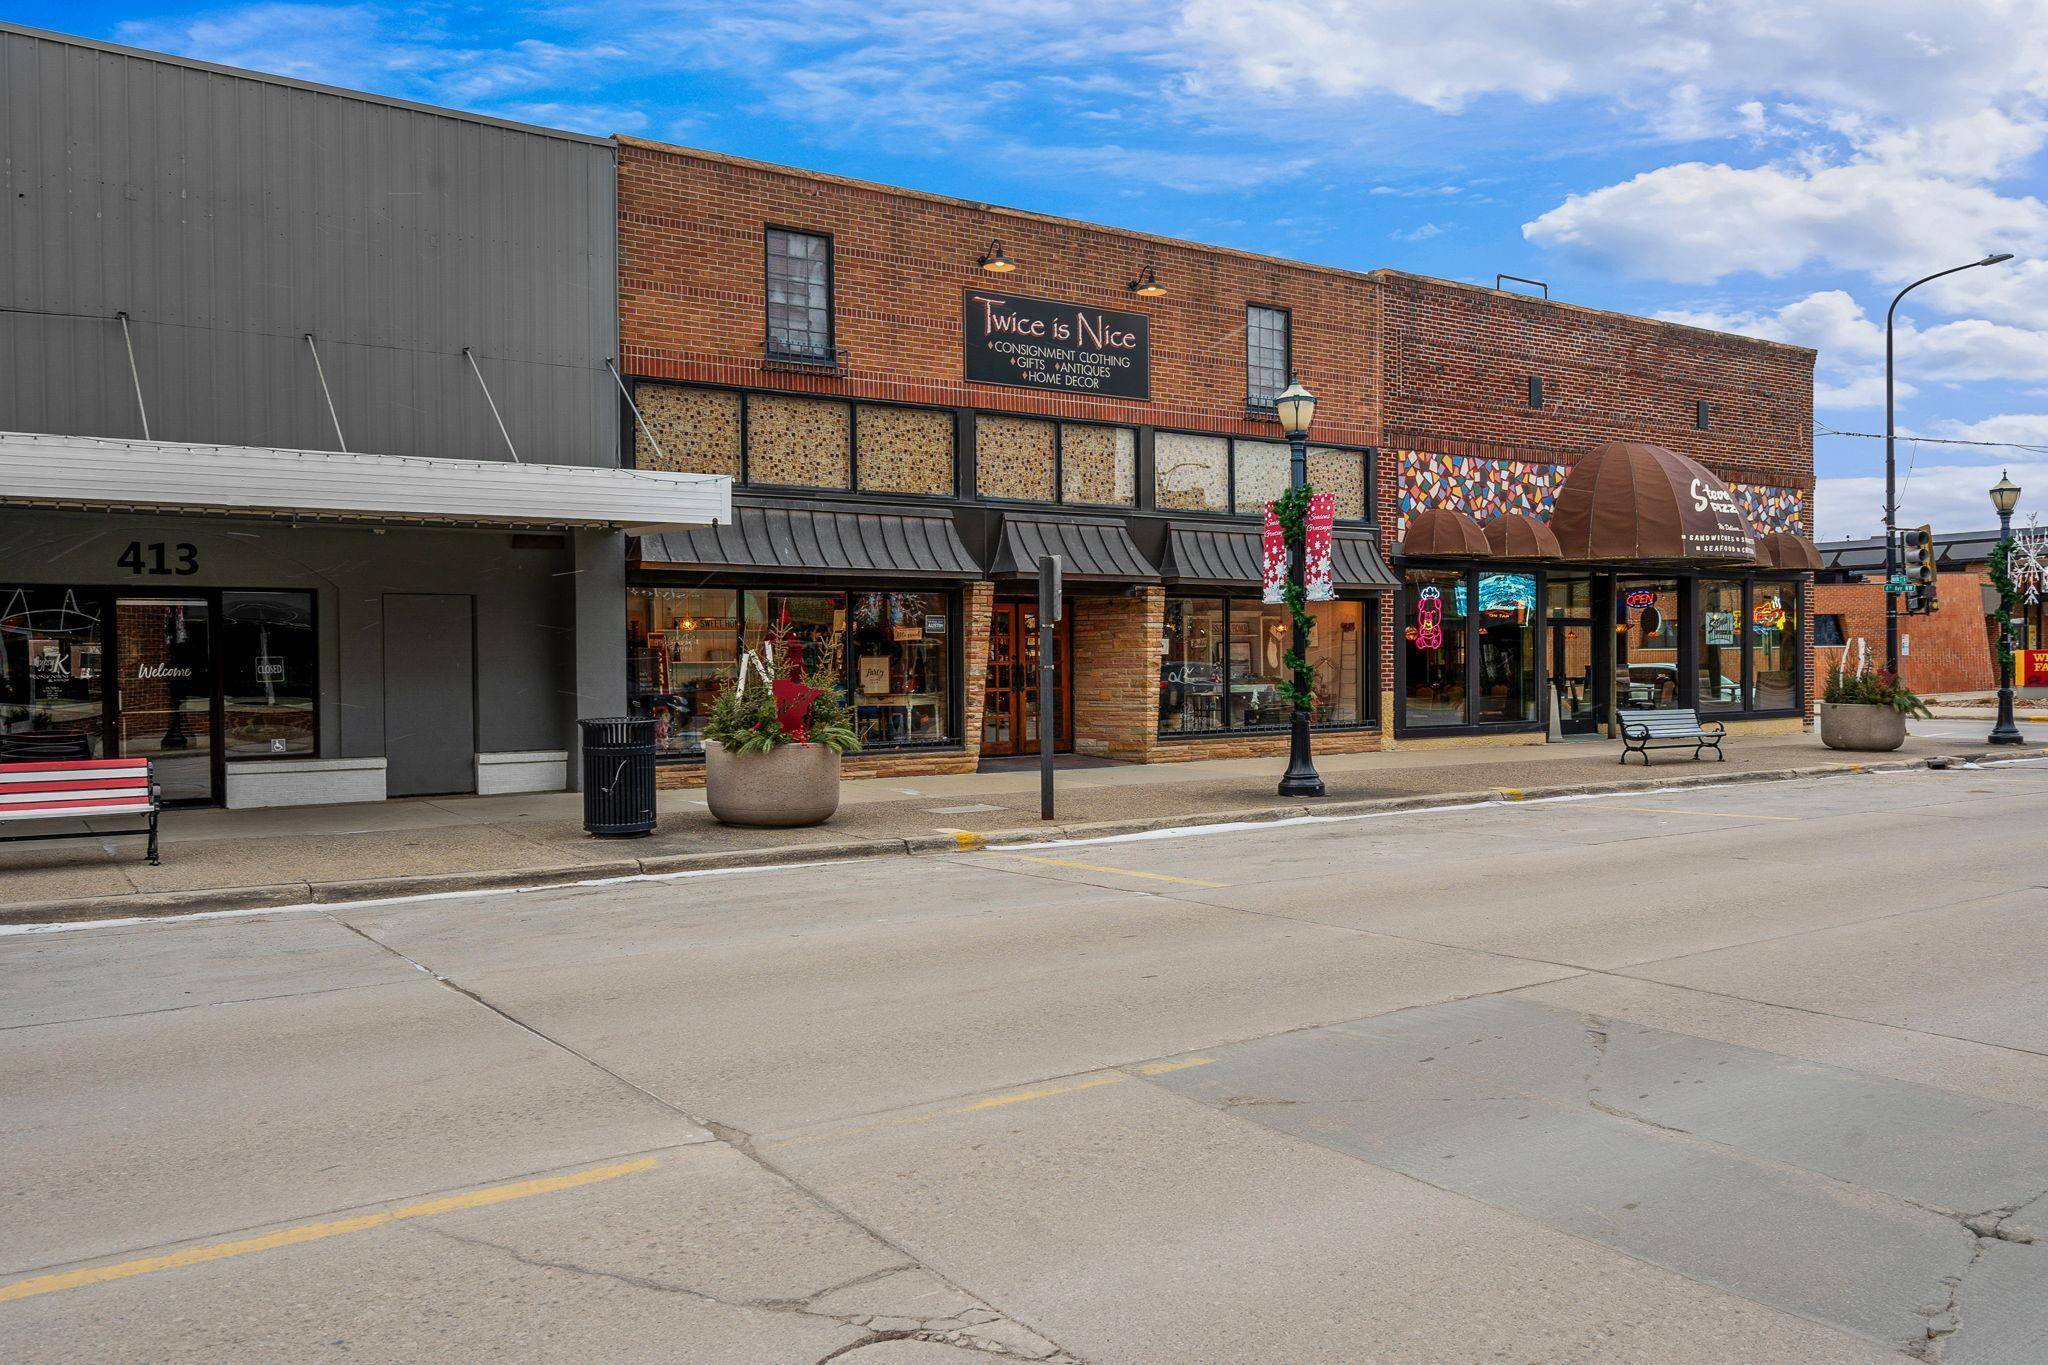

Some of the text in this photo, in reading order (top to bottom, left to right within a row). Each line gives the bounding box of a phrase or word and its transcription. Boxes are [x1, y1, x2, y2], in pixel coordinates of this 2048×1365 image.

[971, 296, 1136, 350] Twice is Nice
[994, 341, 1131, 368] CONSIGNMENT CLOTHING
[1017, 356, 1111, 378] GIFTS ANTIQUES
[1028, 371, 1099, 389] HOME DECOR
[1689, 534, 1735, 543] SANDWICHES
[1703, 545, 1736, 553] SEAFOOD
[117, 541, 199, 576] 413
[1626, 593, 1654, 605] OPEN
[138, 662, 192, 679] Welcome
[257, 664, 283, 675] CLOSED
